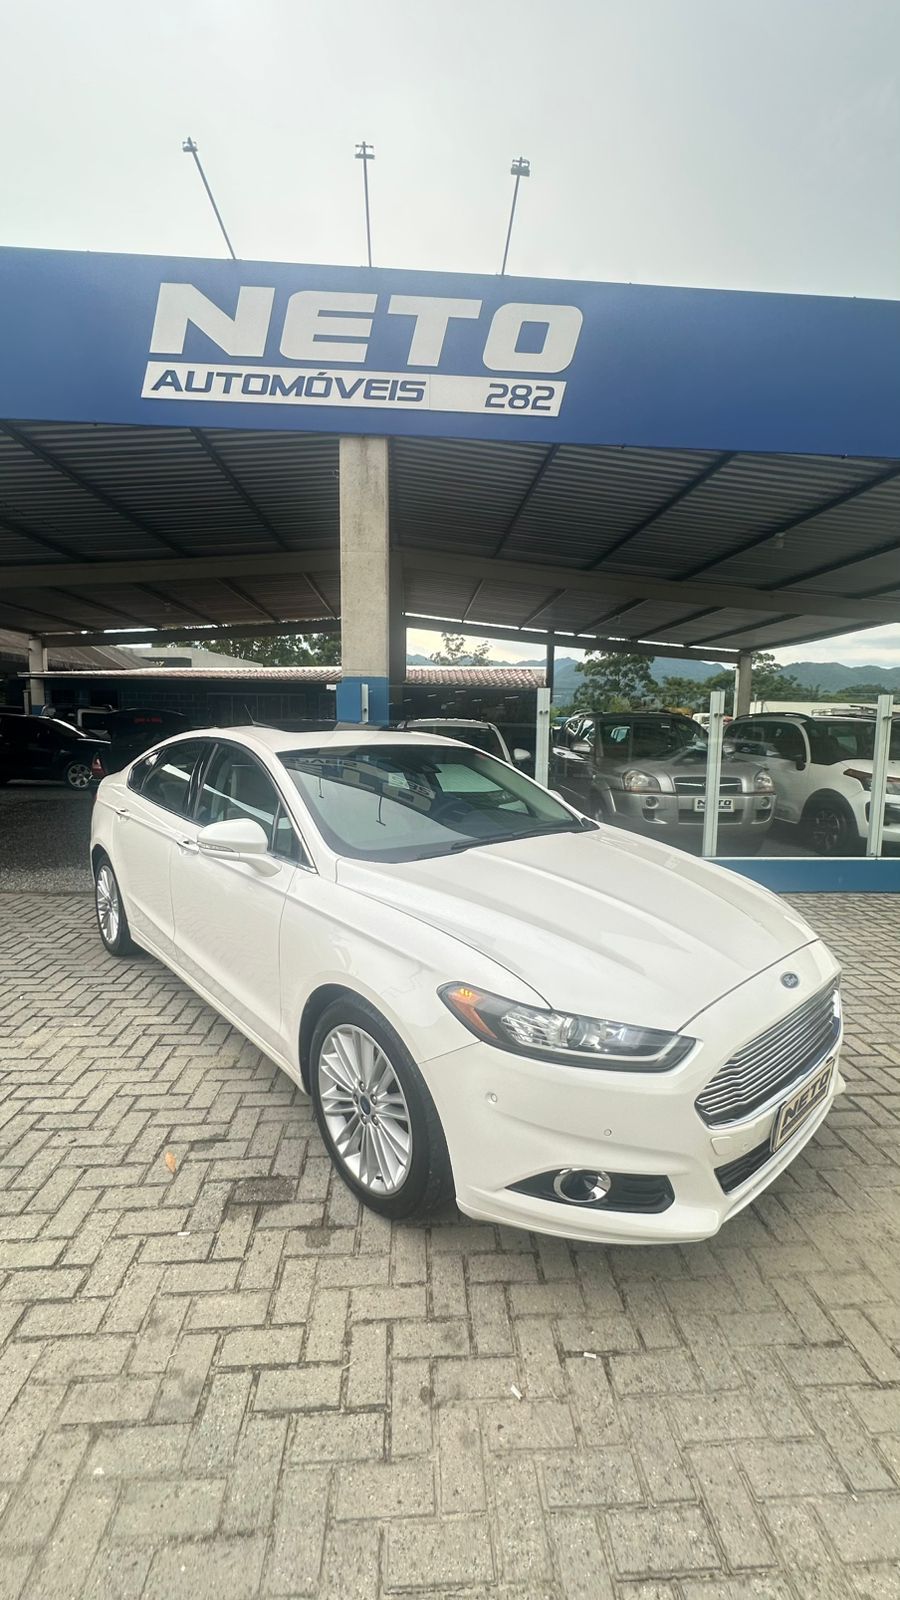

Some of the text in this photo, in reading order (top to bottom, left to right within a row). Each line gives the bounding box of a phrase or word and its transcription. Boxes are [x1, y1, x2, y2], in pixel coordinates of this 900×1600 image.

[149, 282, 584, 373] NETO
[151, 370, 556, 412] AUTOMÓVEIS 282
[782, 1068, 831, 1128] NETO
